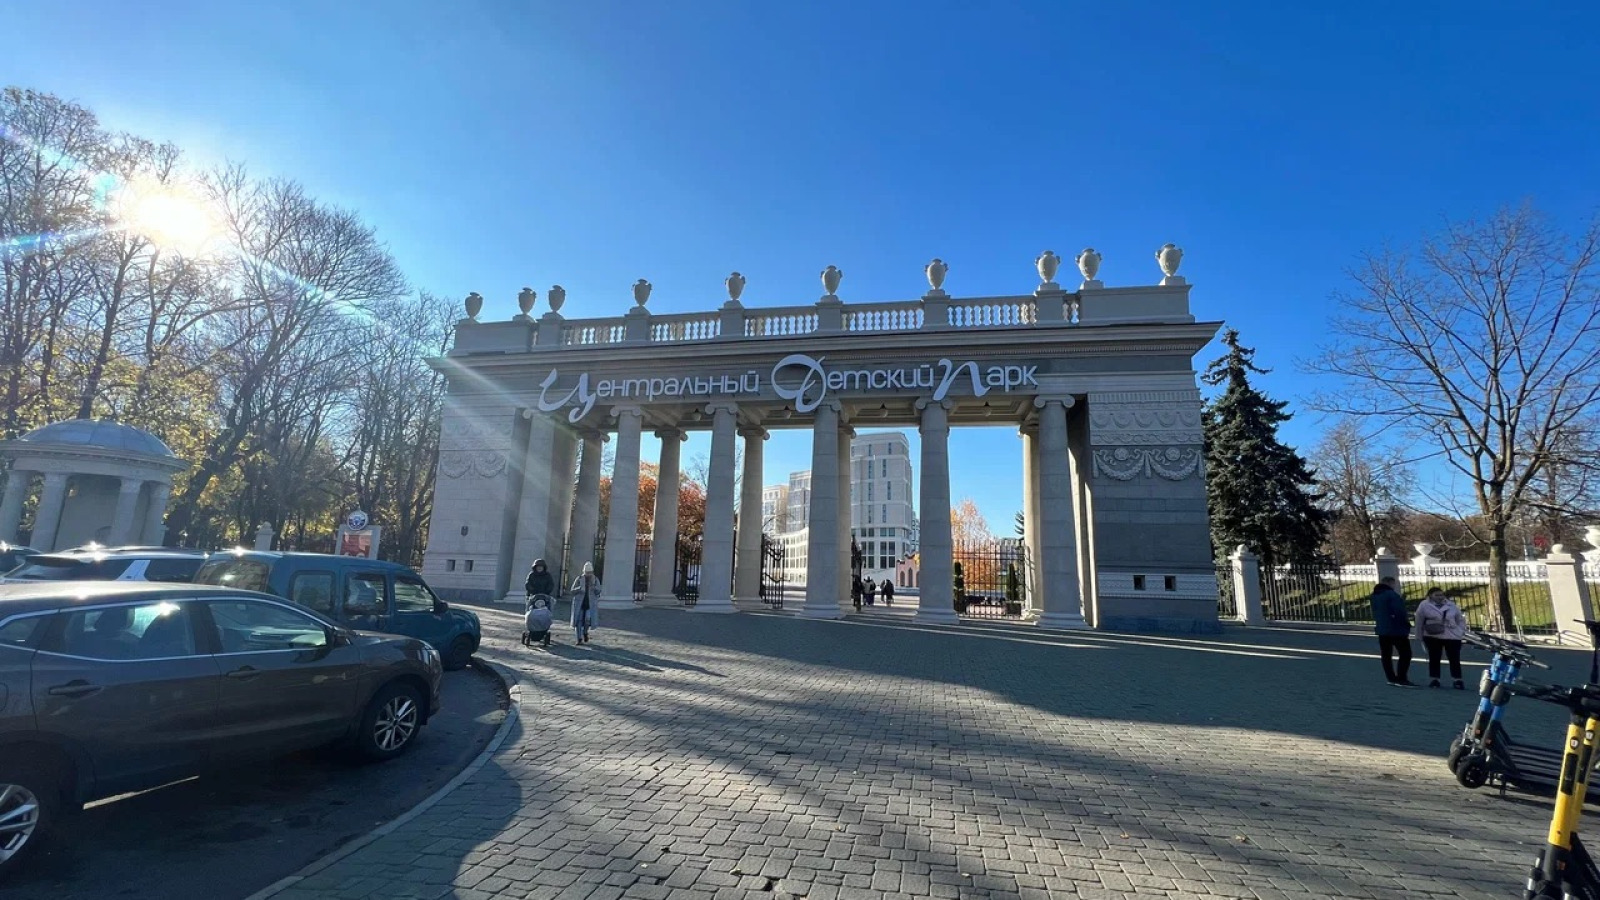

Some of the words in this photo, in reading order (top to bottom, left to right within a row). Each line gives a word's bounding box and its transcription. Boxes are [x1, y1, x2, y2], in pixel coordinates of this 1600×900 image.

[538, 368, 760, 423] Центральный
[771, 354, 934, 412] Детский
[933, 358, 1038, 400] Парк
